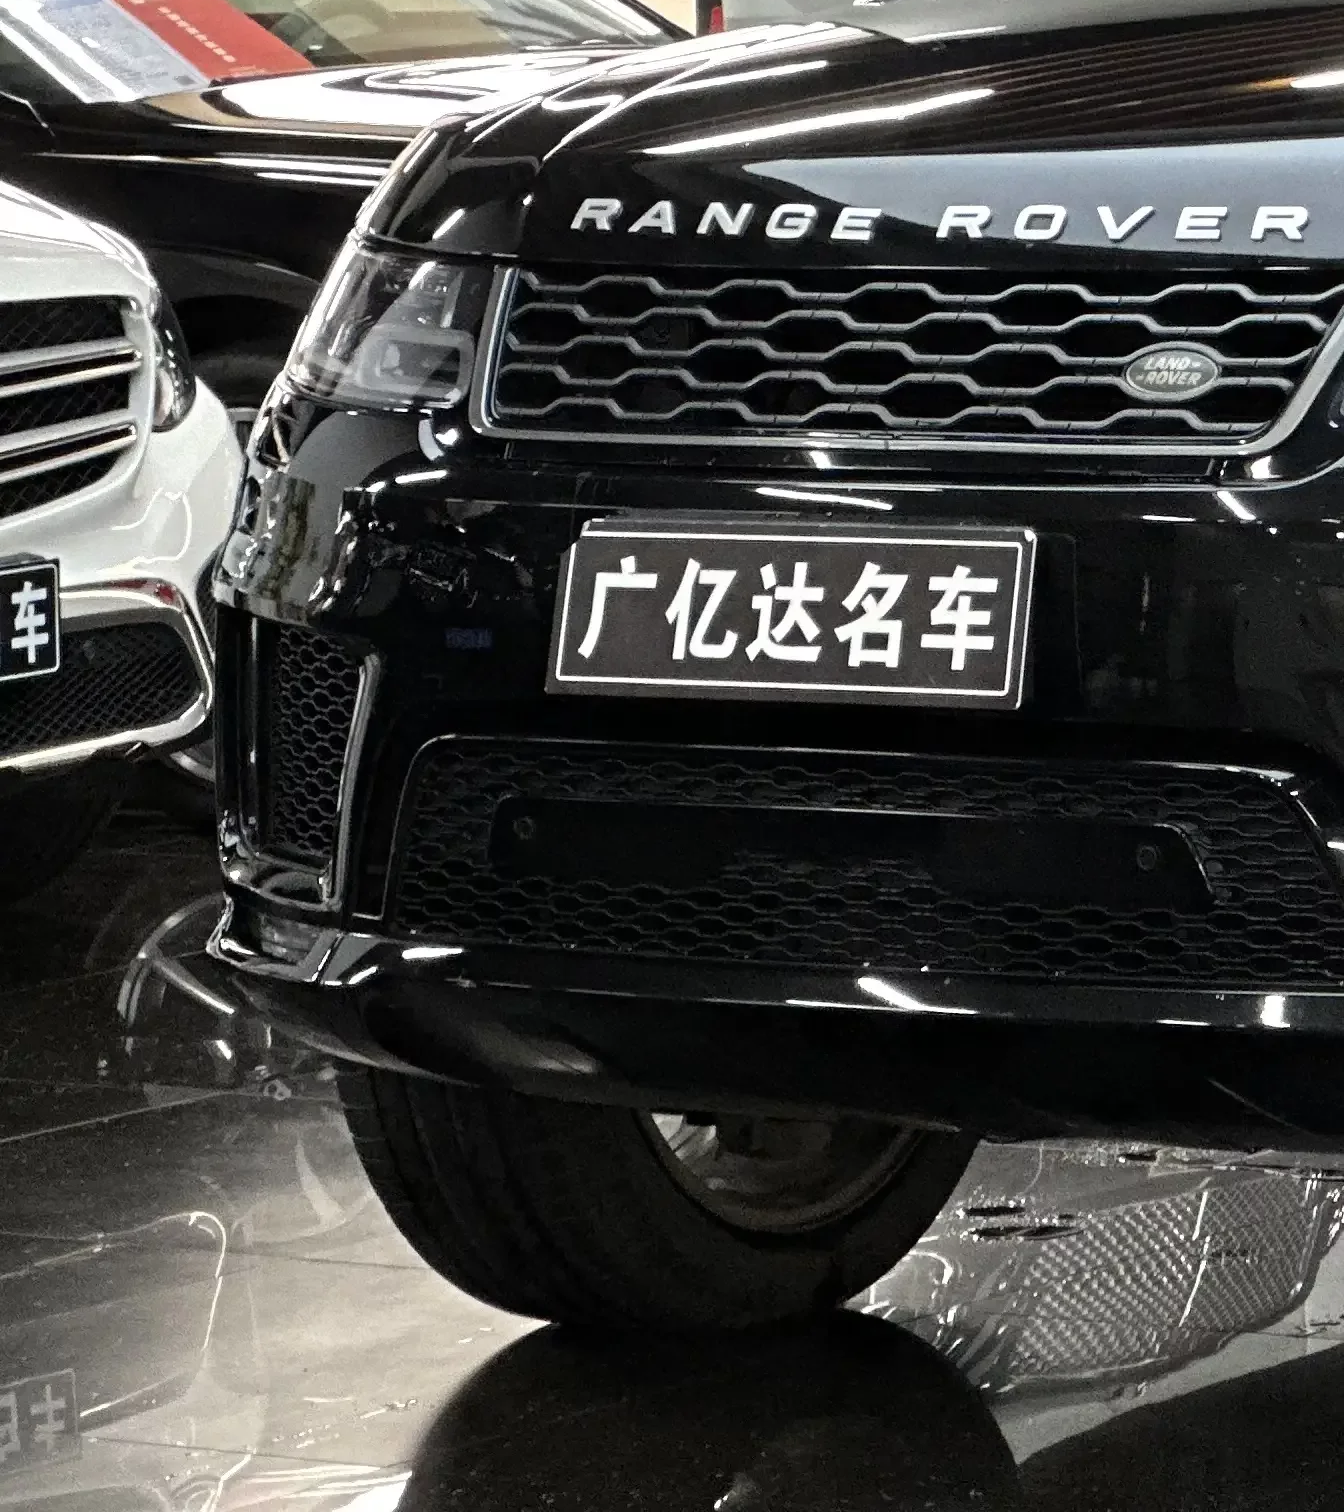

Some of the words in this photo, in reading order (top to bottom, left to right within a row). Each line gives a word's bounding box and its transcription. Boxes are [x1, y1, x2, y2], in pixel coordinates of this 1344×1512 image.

[570, 198, 883, 242] RANGE
[936, 204, 1309, 241] ROVER
[577, 554, 1000, 672] 广亿达名车
